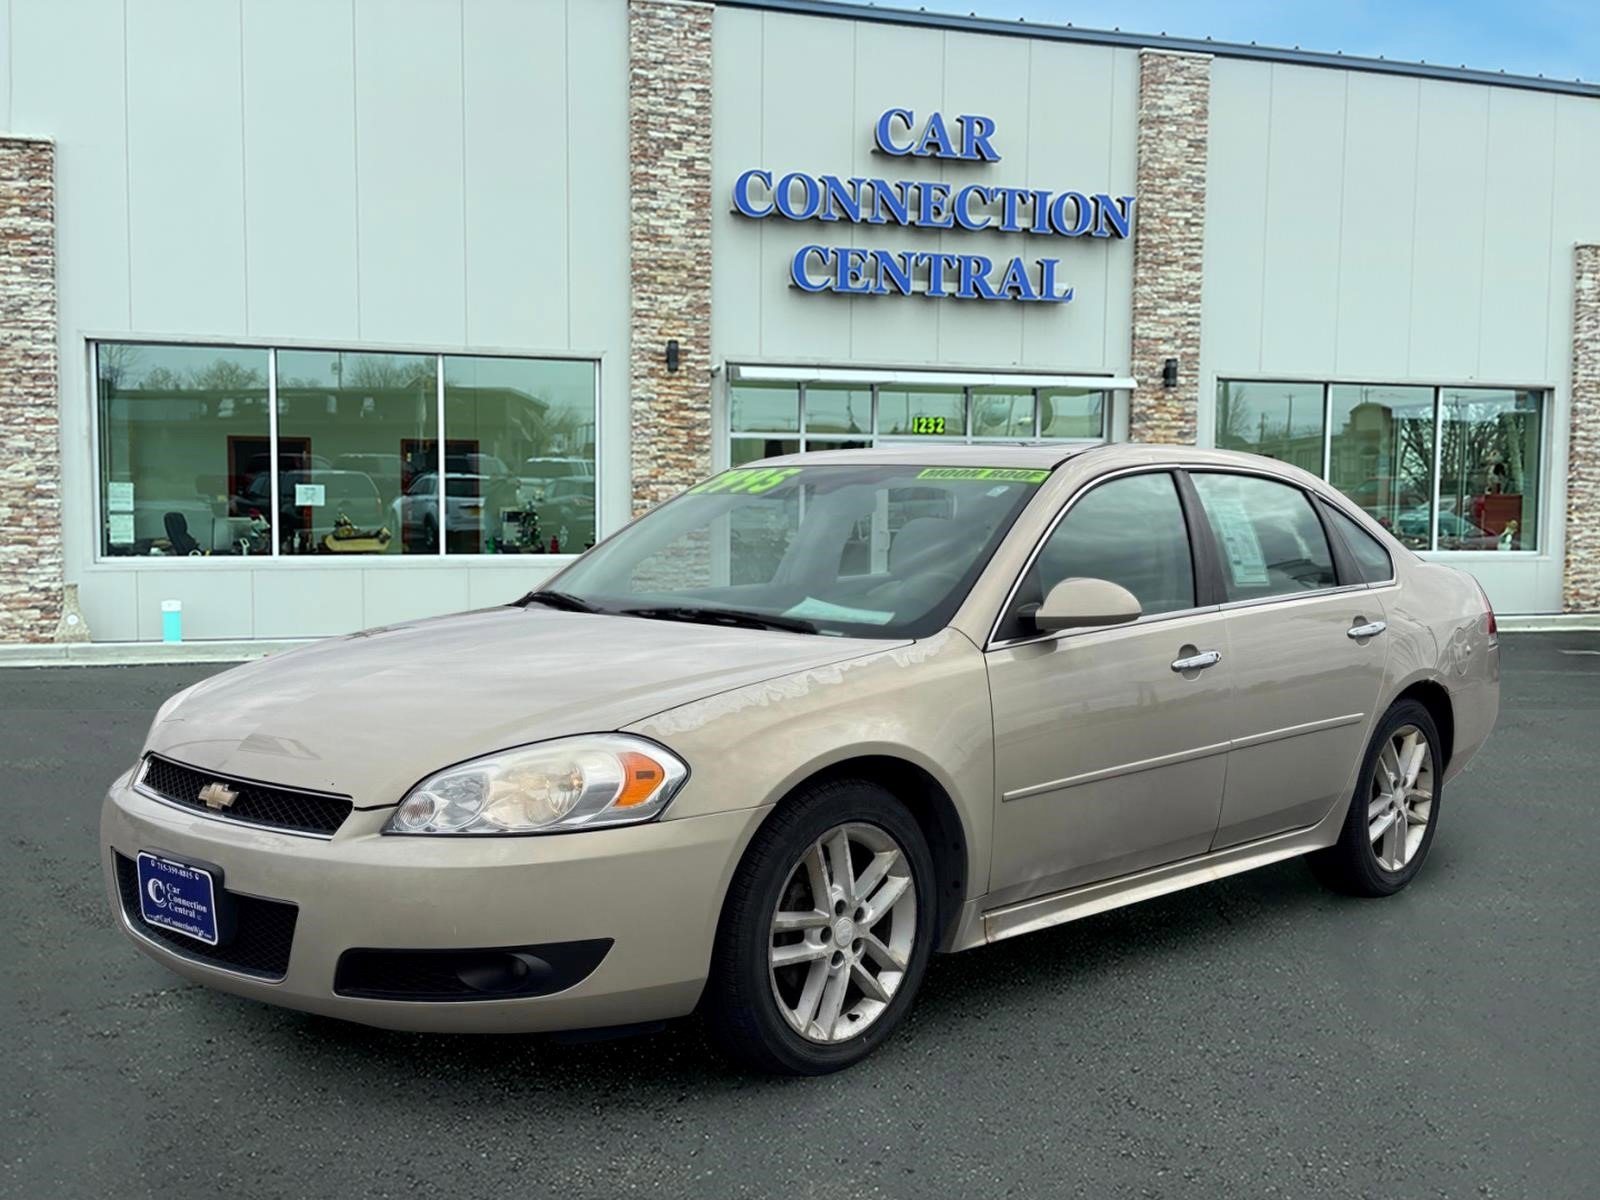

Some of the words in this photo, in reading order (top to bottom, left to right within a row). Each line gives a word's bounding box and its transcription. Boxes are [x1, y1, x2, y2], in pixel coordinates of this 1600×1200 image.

[873, 108, 1001, 162] CAR
[732, 169, 1136, 240] CONNECTION
[790, 245, 1075, 303] CENTRAL
[912, 416, 945, 434] 1232
[166, 882, 181, 895] Car
[167, 892, 208, 913] Connection
[168, 901, 196, 919] Central
